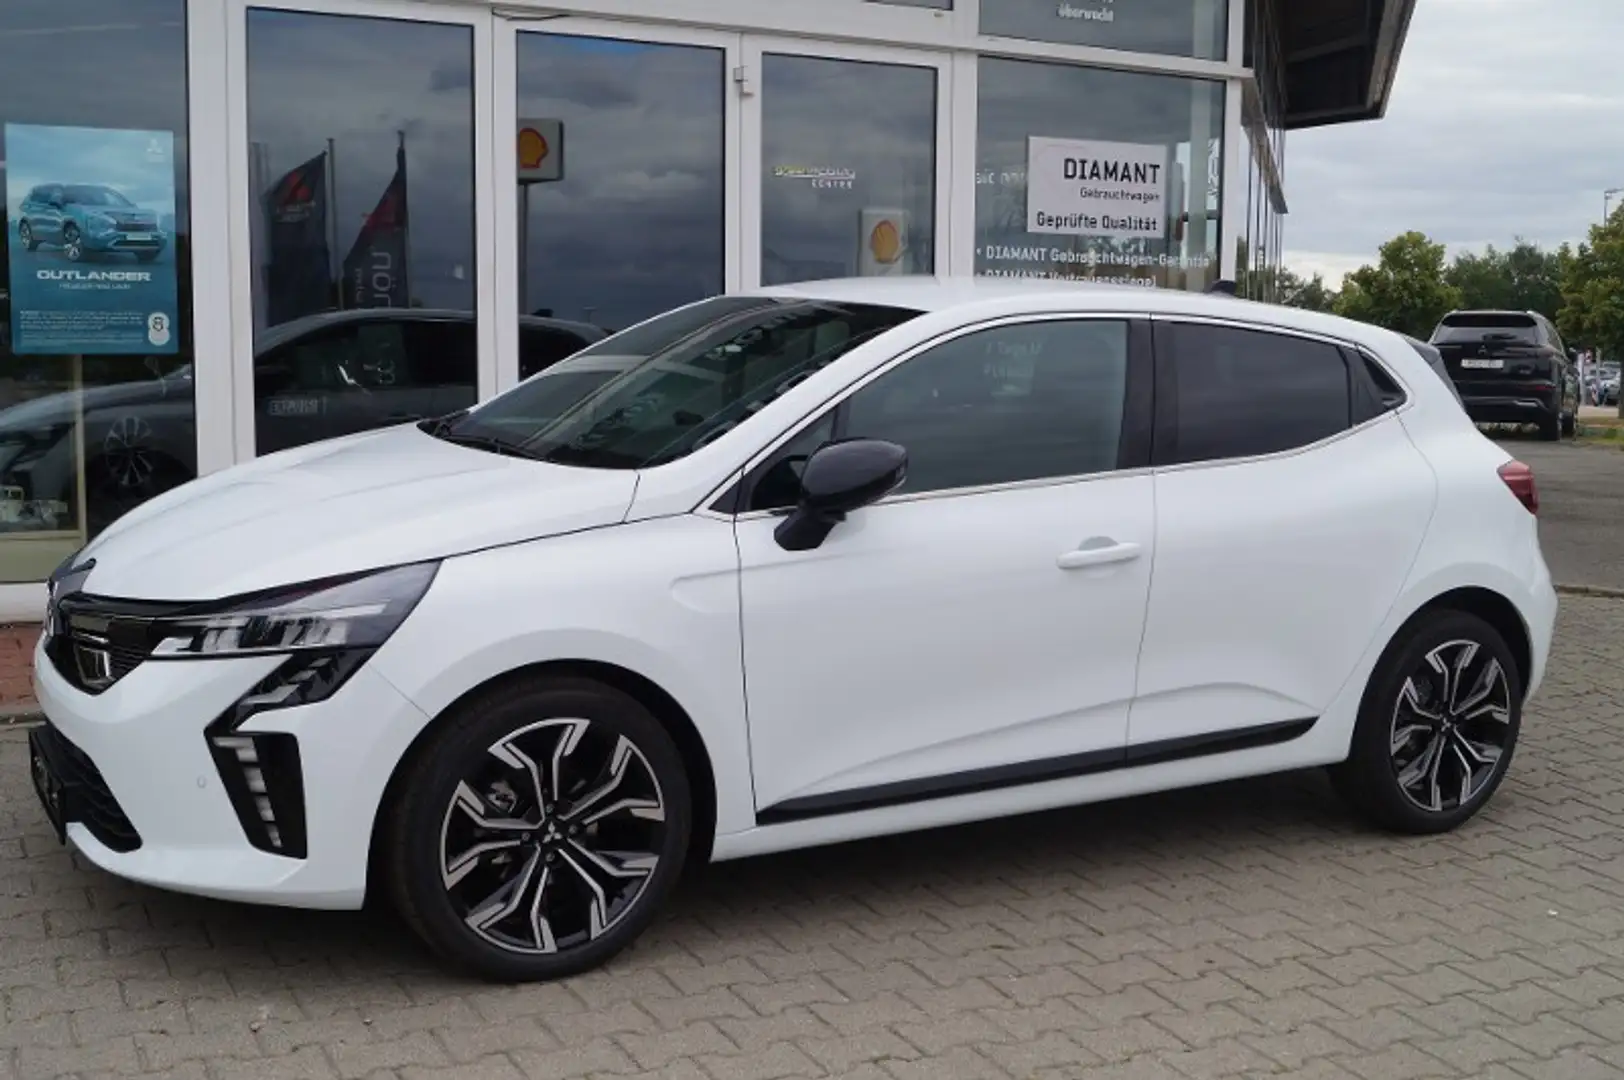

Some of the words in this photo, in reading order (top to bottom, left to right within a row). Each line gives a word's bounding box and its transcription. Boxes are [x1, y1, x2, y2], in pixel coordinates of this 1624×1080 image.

[1063, 157, 1160, 184] DIAMANT
[1080, 187, 1160, 204] Gebrauchtwagen
[1036, 211, 1097, 229] Geprüfte
[1102, 215, 1157, 230] Qualität
[986, 245, 1047, 261] DIAMANT
[36, 269, 152, 281] OUTLANDER
